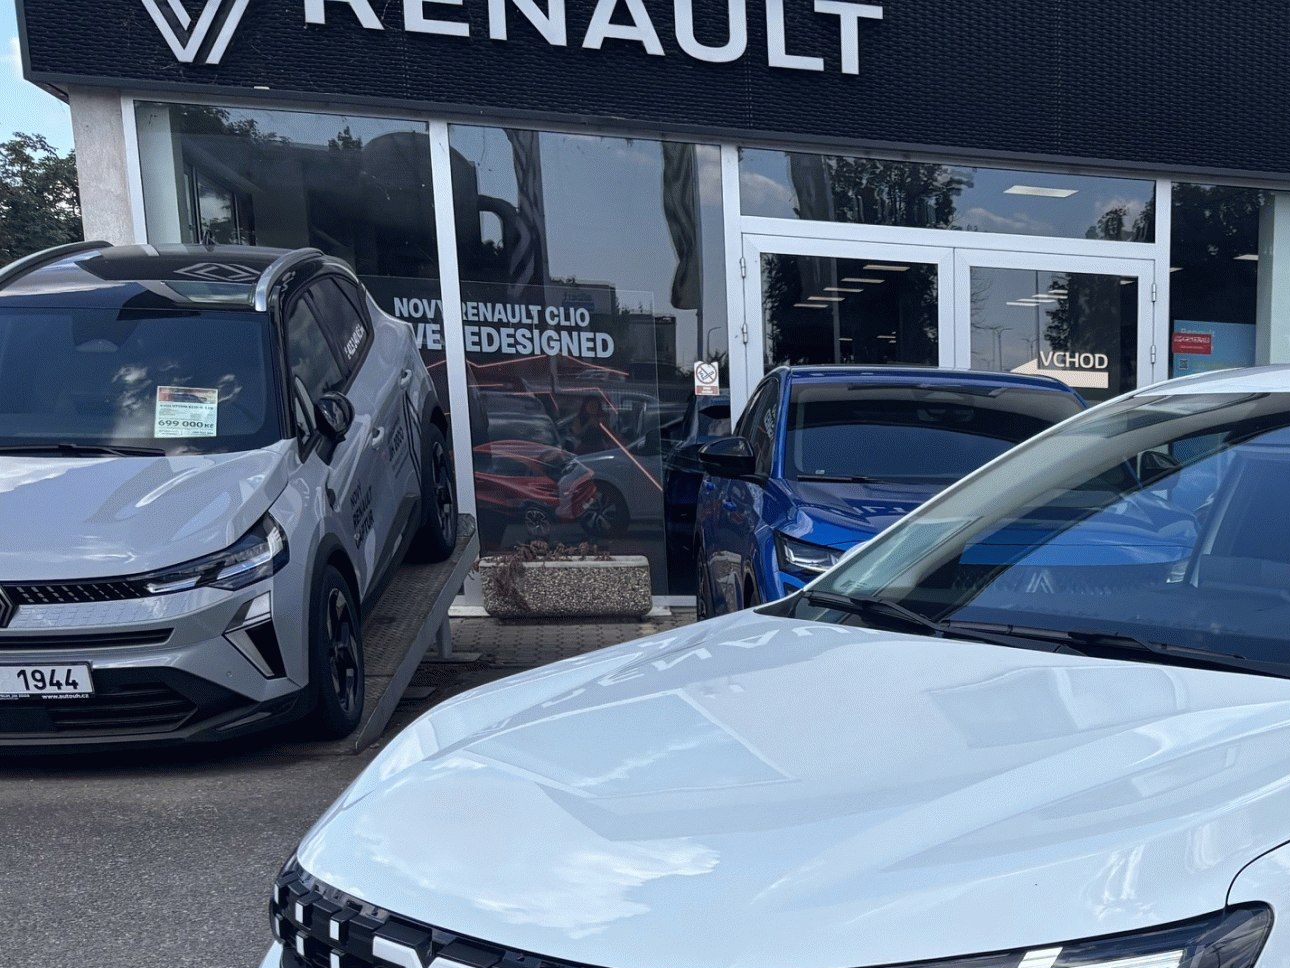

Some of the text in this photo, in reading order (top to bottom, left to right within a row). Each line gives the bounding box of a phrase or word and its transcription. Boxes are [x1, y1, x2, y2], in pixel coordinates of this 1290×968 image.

[545, 306, 590, 327] CLIO
[464, 325, 615, 358] EDESIGNED
[1040, 351, 1108, 369] VCHOD
[16, 668, 79, 691] 1944
